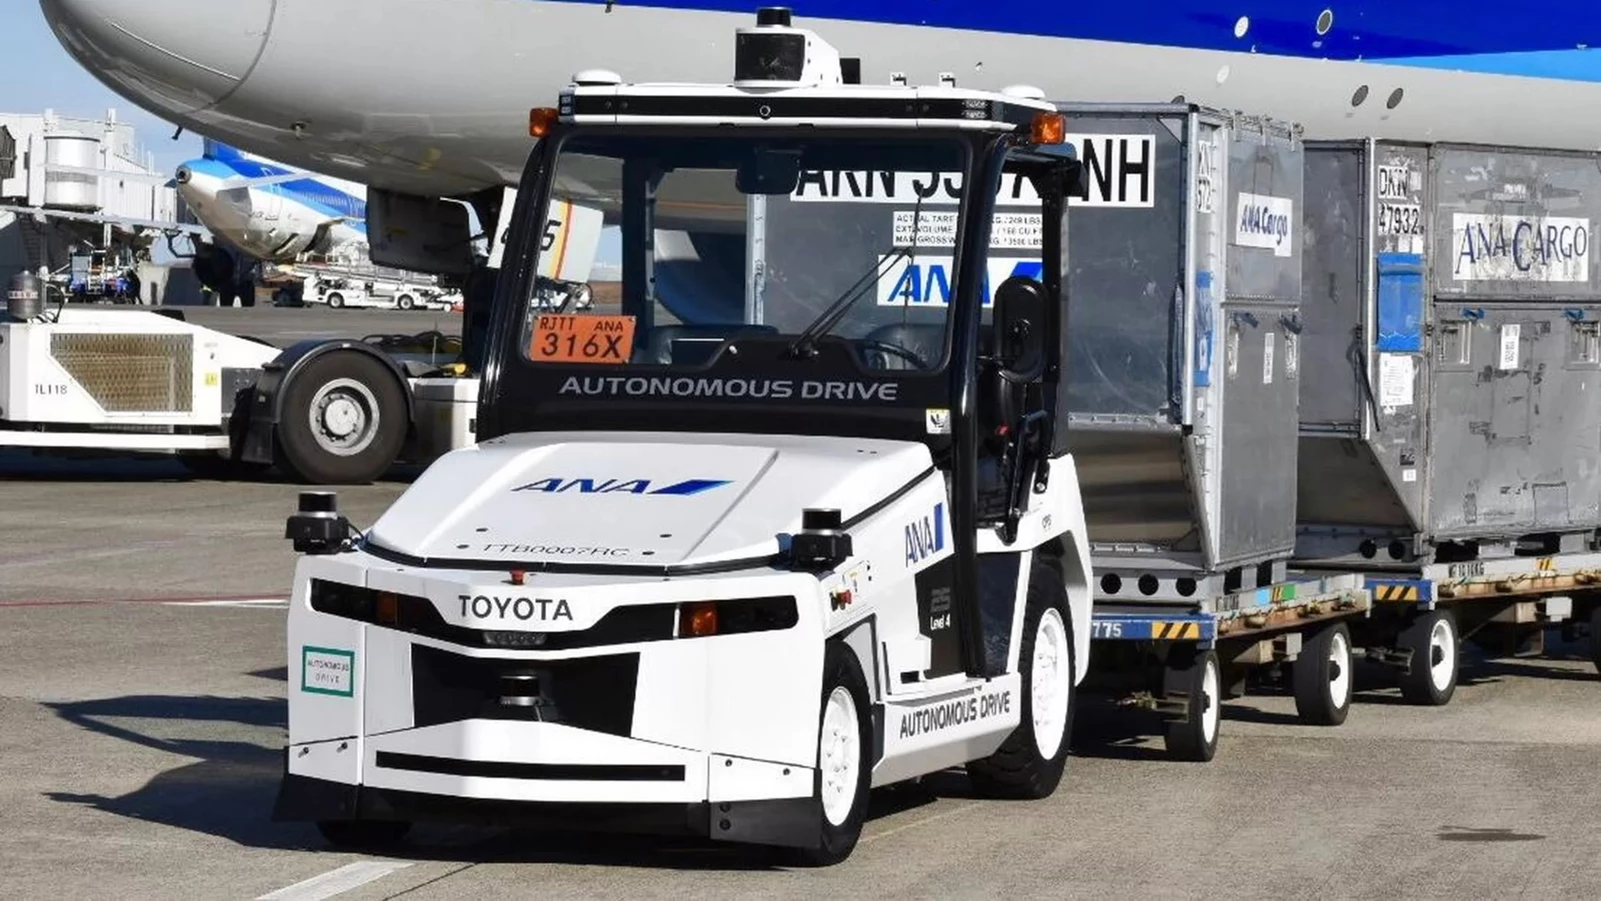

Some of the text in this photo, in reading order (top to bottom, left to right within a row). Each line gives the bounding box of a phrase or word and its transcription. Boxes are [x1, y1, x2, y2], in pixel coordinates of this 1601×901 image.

[896, 214, 930, 223] ACTAL
[1454, 219, 1588, 274] ANA CARGO
[887, 264, 991, 305] AN
[539, 316, 624, 333] RJTT ANA
[541, 332, 624, 359] 316X
[559, 376, 899, 401] AUTONOMOUS DRIVE
[510, 478, 652, 494] ANA
[904, 514, 937, 568] ANA
[457, 593, 574, 622] TOYOTA
[1092, 622, 1122, 639] 775
[899, 690, 1011, 740] AUTONOMOUS DRIVE
